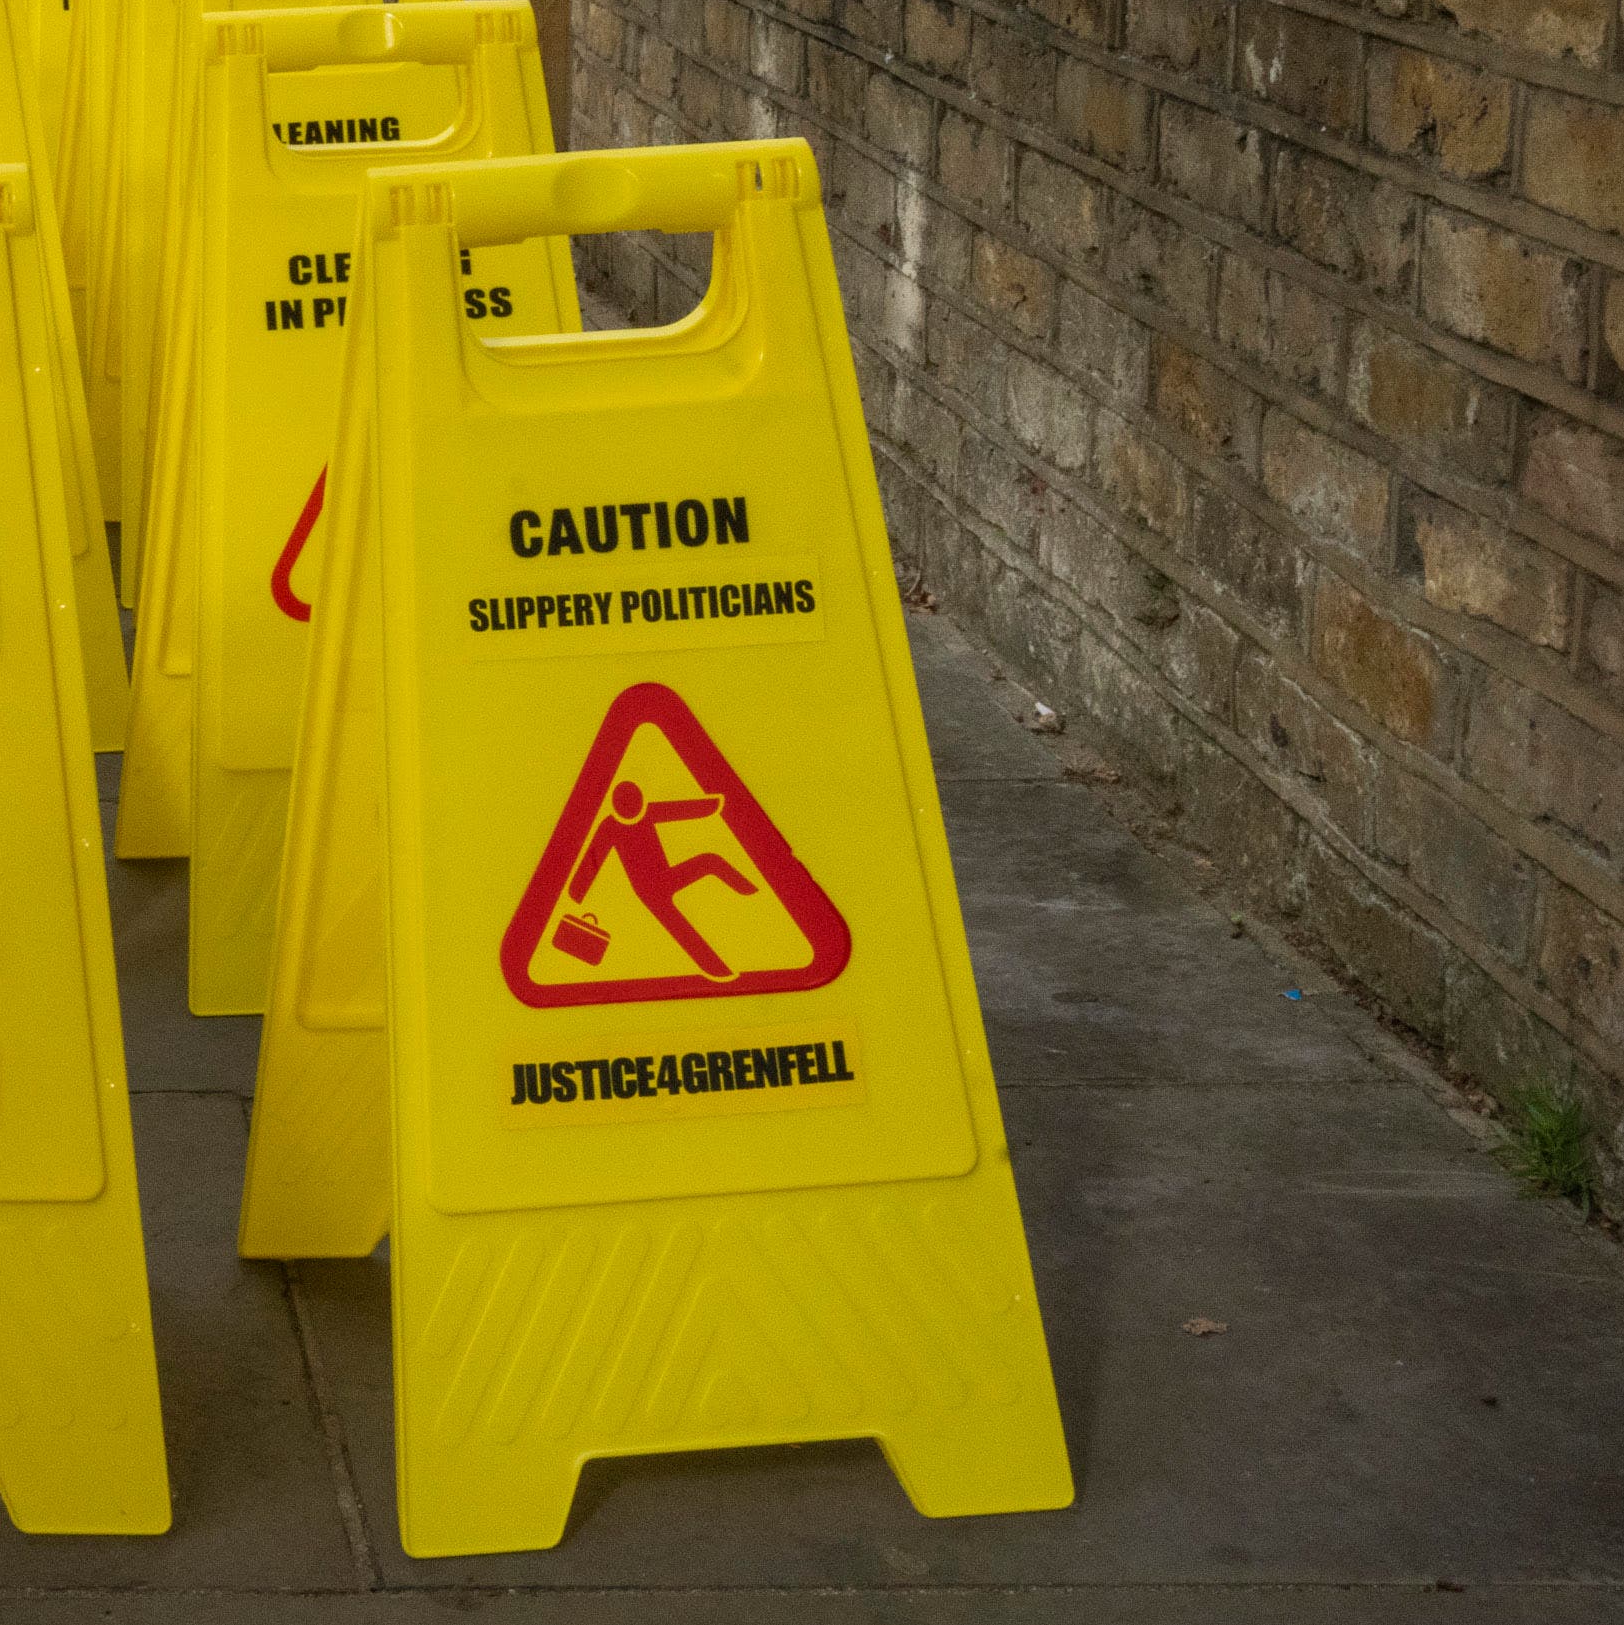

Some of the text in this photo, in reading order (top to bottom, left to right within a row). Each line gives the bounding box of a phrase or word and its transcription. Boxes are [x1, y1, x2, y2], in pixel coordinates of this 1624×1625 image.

[266, 300, 303, 330] IN
[510, 497, 749, 558] CAUTION
[469, 580, 815, 631] SLIPPERY POLITICIANS
[512, 1041, 854, 1104] JUSTICE4GRENFELL
